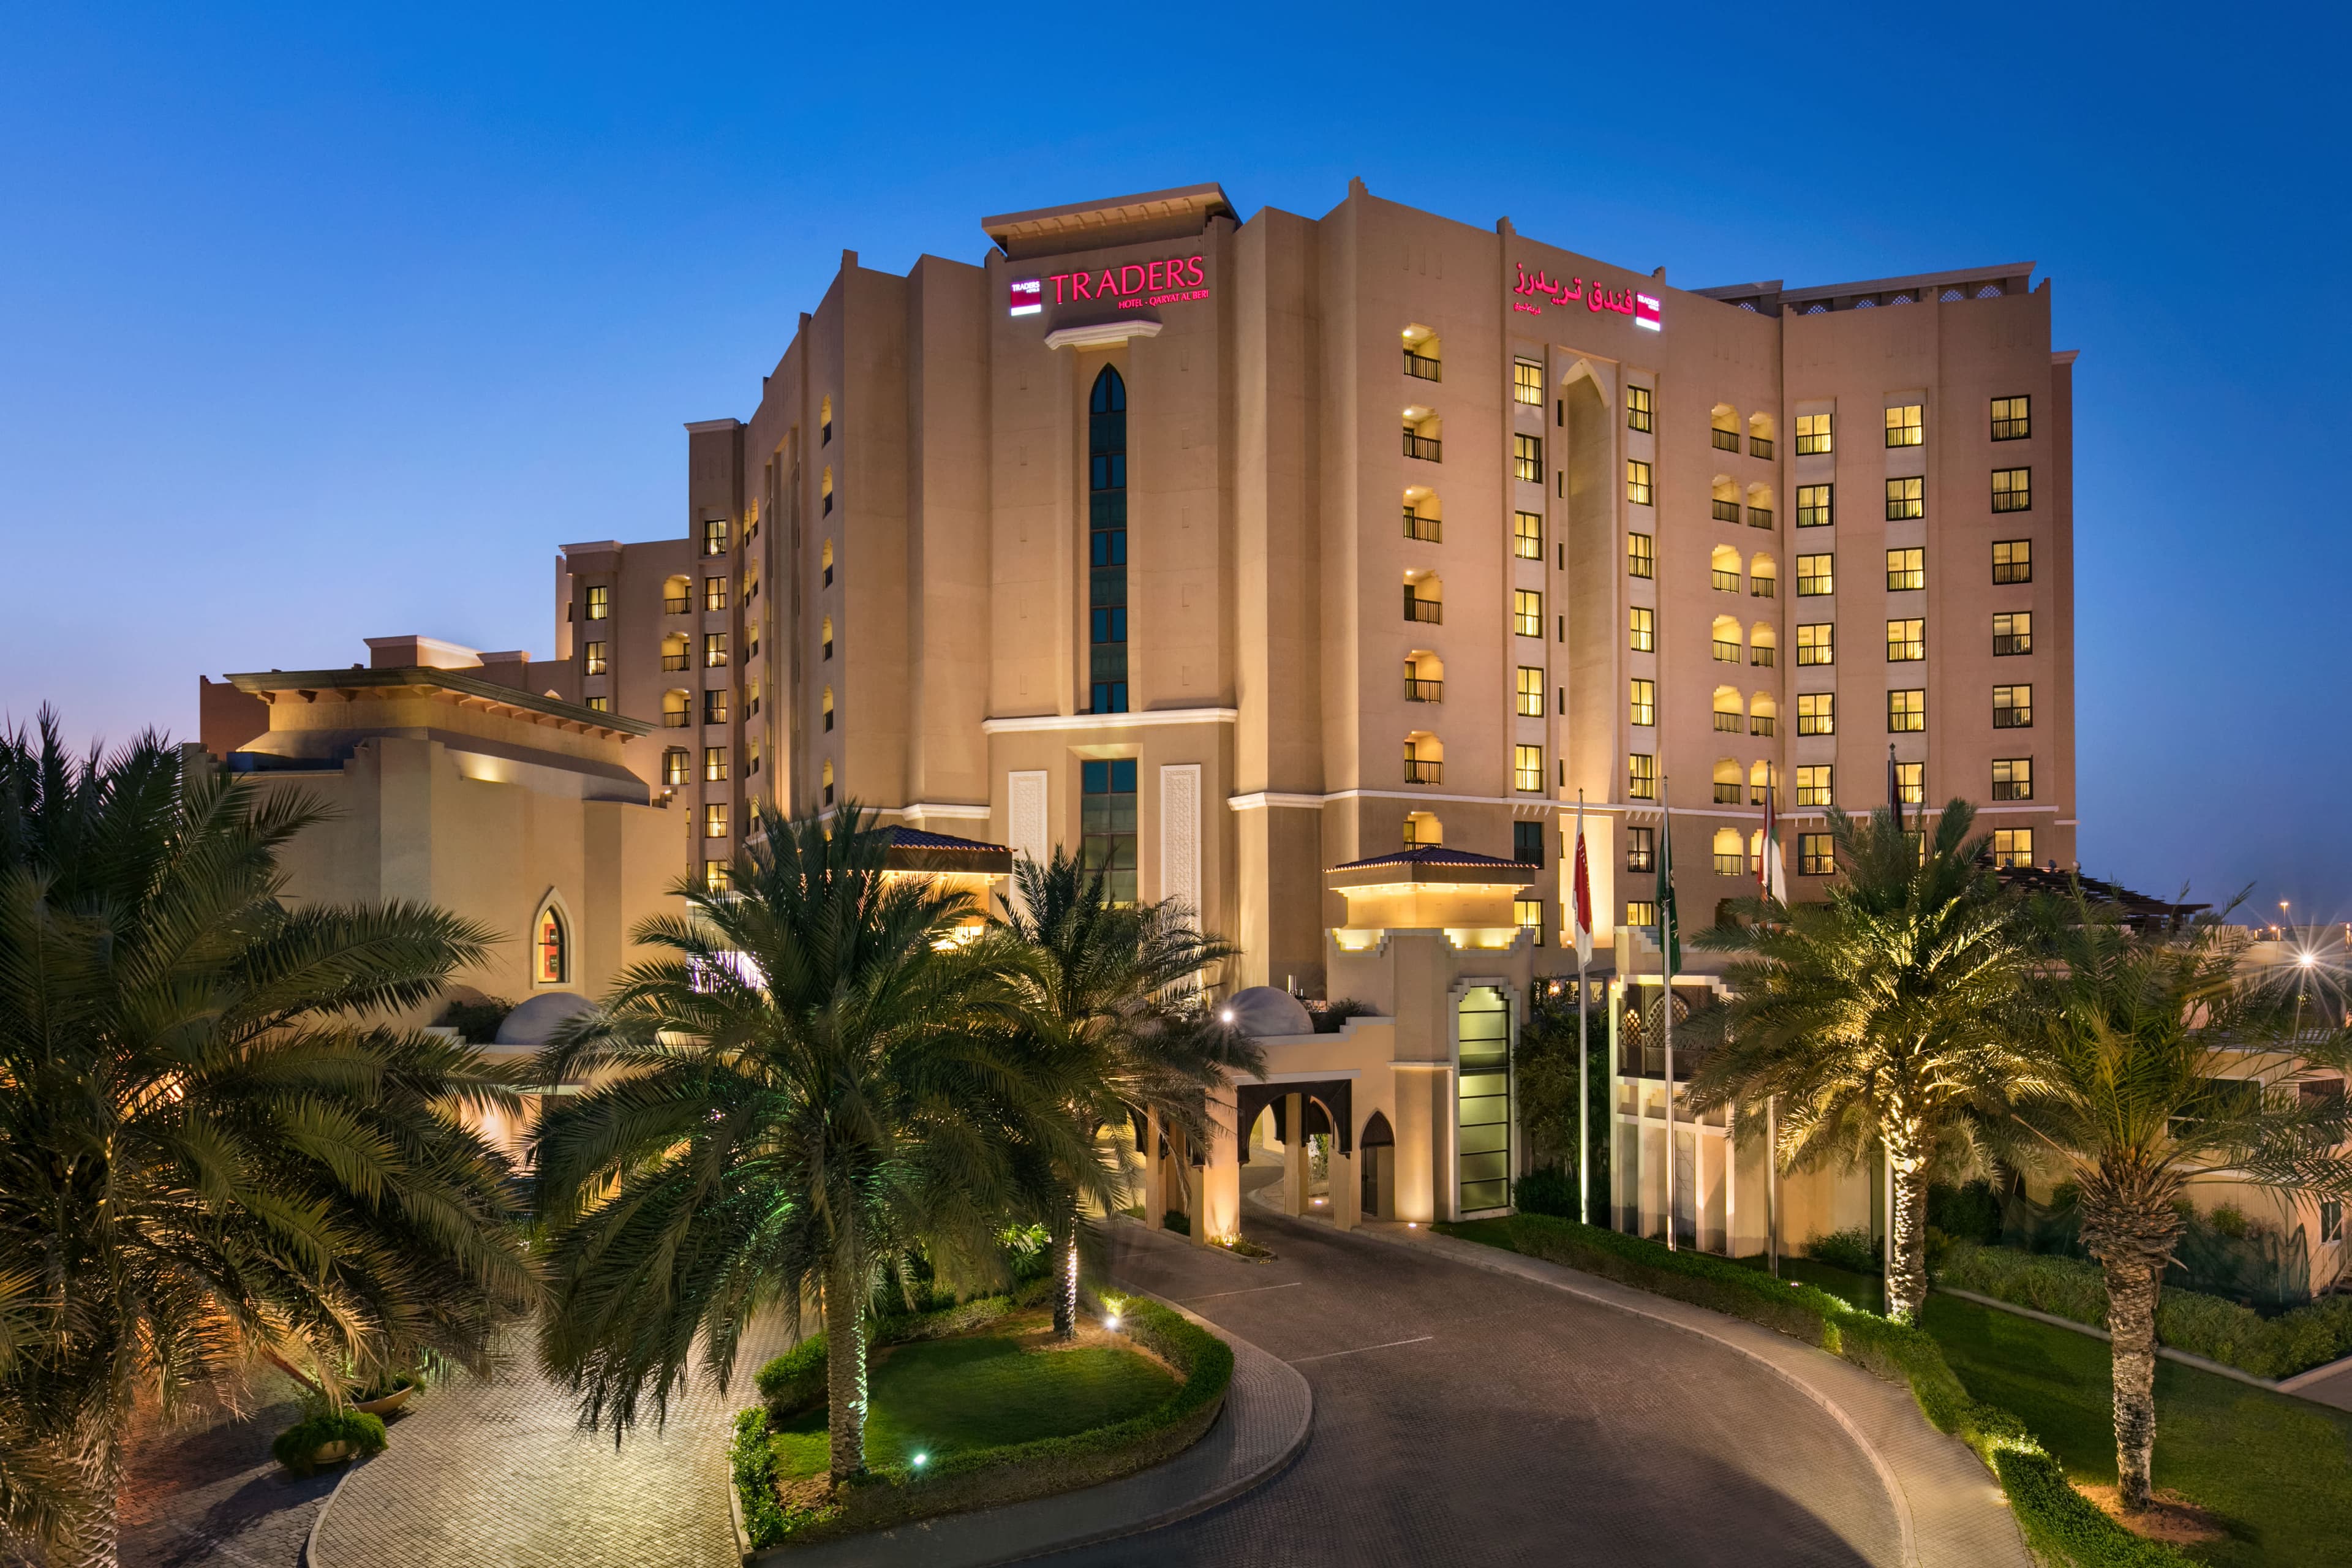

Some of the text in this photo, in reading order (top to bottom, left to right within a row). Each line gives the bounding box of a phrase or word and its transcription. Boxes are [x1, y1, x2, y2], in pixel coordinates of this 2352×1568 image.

[1012, 281, 1040, 292] TRADERS
[1049, 255, 1205, 304] TRADERS
[1513, 262, 1634, 315] فندق تريدرز
[1117, 298, 1144, 309] HOTEL
[1148, 292, 1180, 307] QARYAT
[1180, 292, 1191, 302] AL
[1193, 288, 1210, 300] BERI
